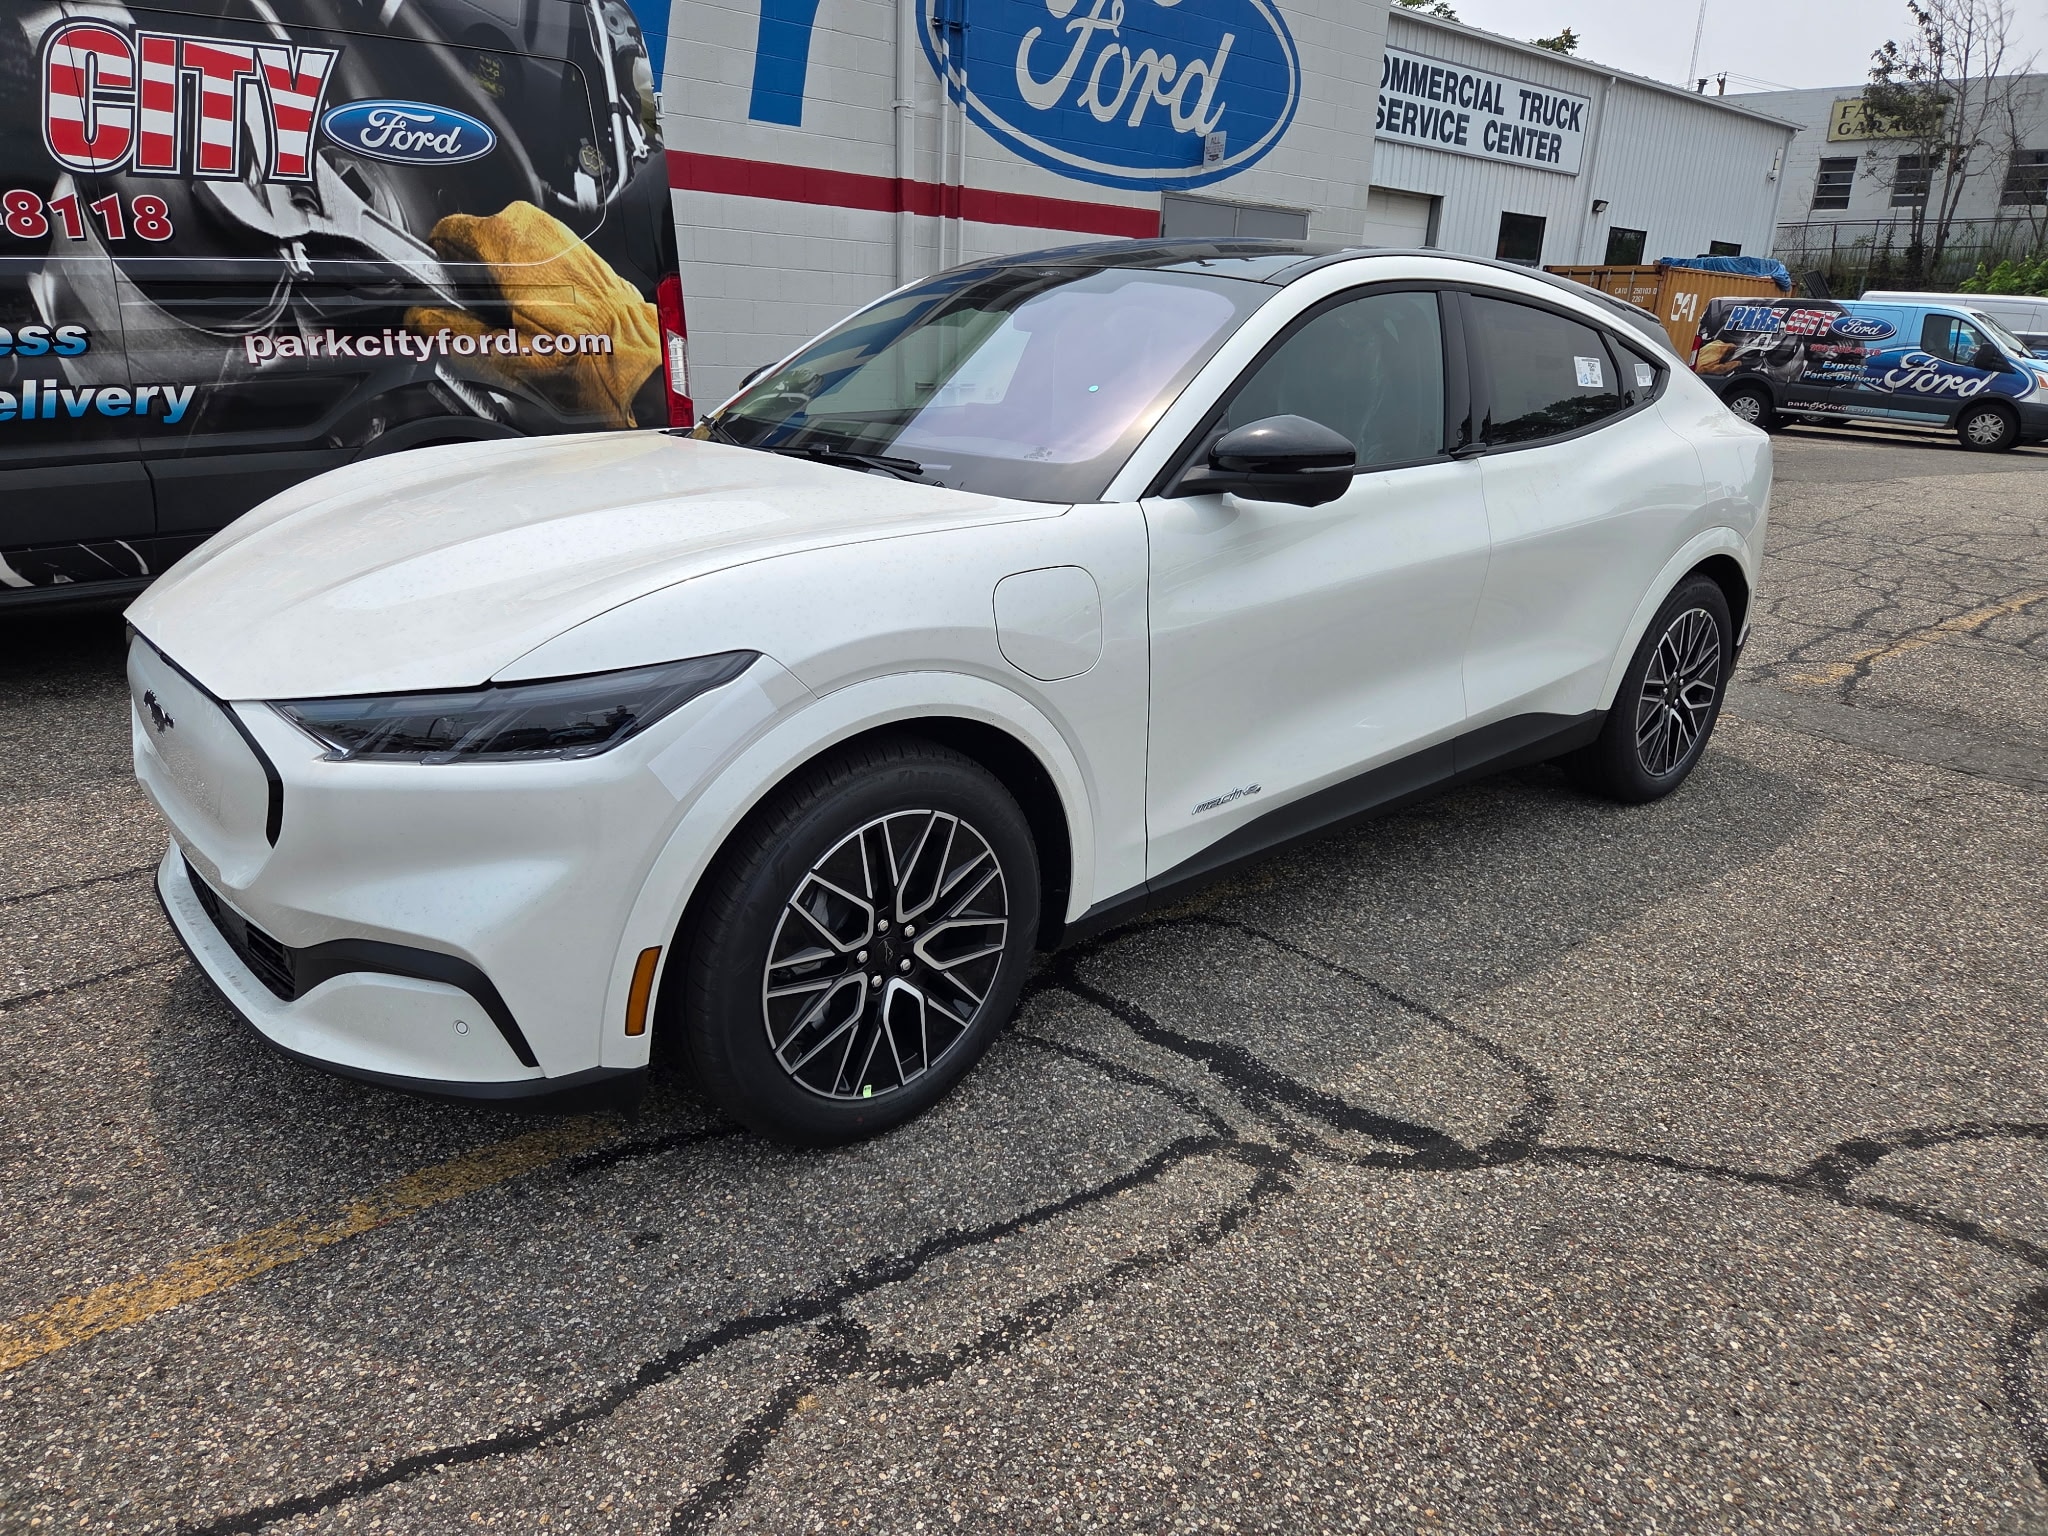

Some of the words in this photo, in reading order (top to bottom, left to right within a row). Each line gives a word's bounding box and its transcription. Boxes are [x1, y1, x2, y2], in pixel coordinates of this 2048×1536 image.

[1016, 0, 1235, 137] Ford
[41, 18, 339, 182] CITY
[1519, 88, 1583, 132] TRUCK
[360, 108, 462, 155] Ford
[1376, 94, 1470, 147] SERVICE
[1484, 119, 1562, 164] CENTER
[0, 188, 174, 242] 8118
[1724, 305, 1789, 334] PARK
[1784, 309, 1842, 337] CITY
[1842, 318, 1880, 336] Ford
[245, 327, 613, 364] parkcityford.com
[1822, 360, 1869, 372] Express
[1803, 370, 1833, 381] Parts
[1835, 373, 1883, 385] Delivery
[1884, 351, 2000, 397] Ford
